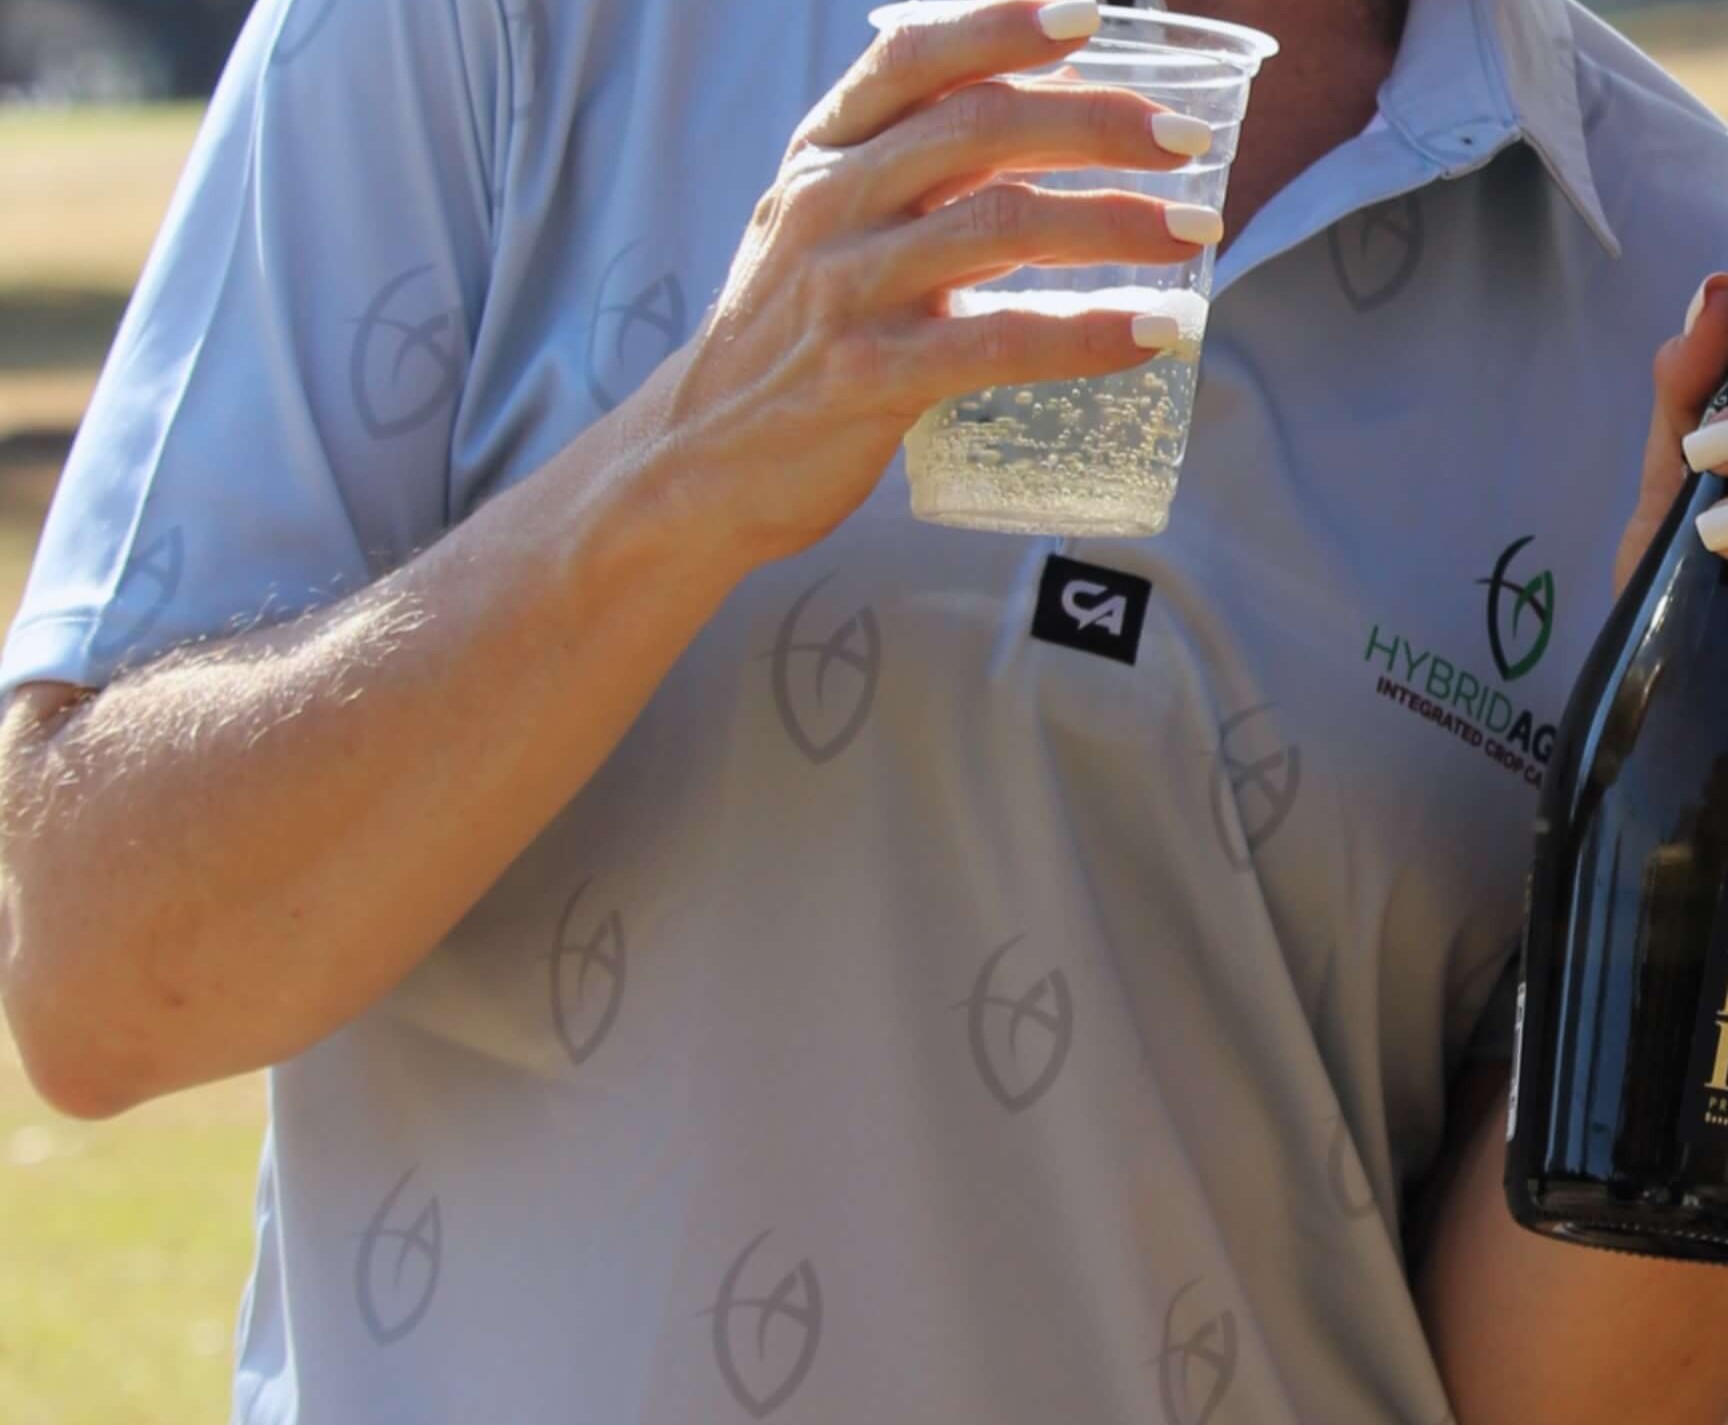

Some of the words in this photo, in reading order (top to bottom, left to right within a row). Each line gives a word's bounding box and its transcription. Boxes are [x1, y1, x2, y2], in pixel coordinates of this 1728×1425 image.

[1364, 624, 1556, 765] HYBRIDAG
[1376, 675, 1483, 748] INTEGRATED
[1483, 738, 1525, 774] CROP
[1522, 764, 1543, 791] CA
